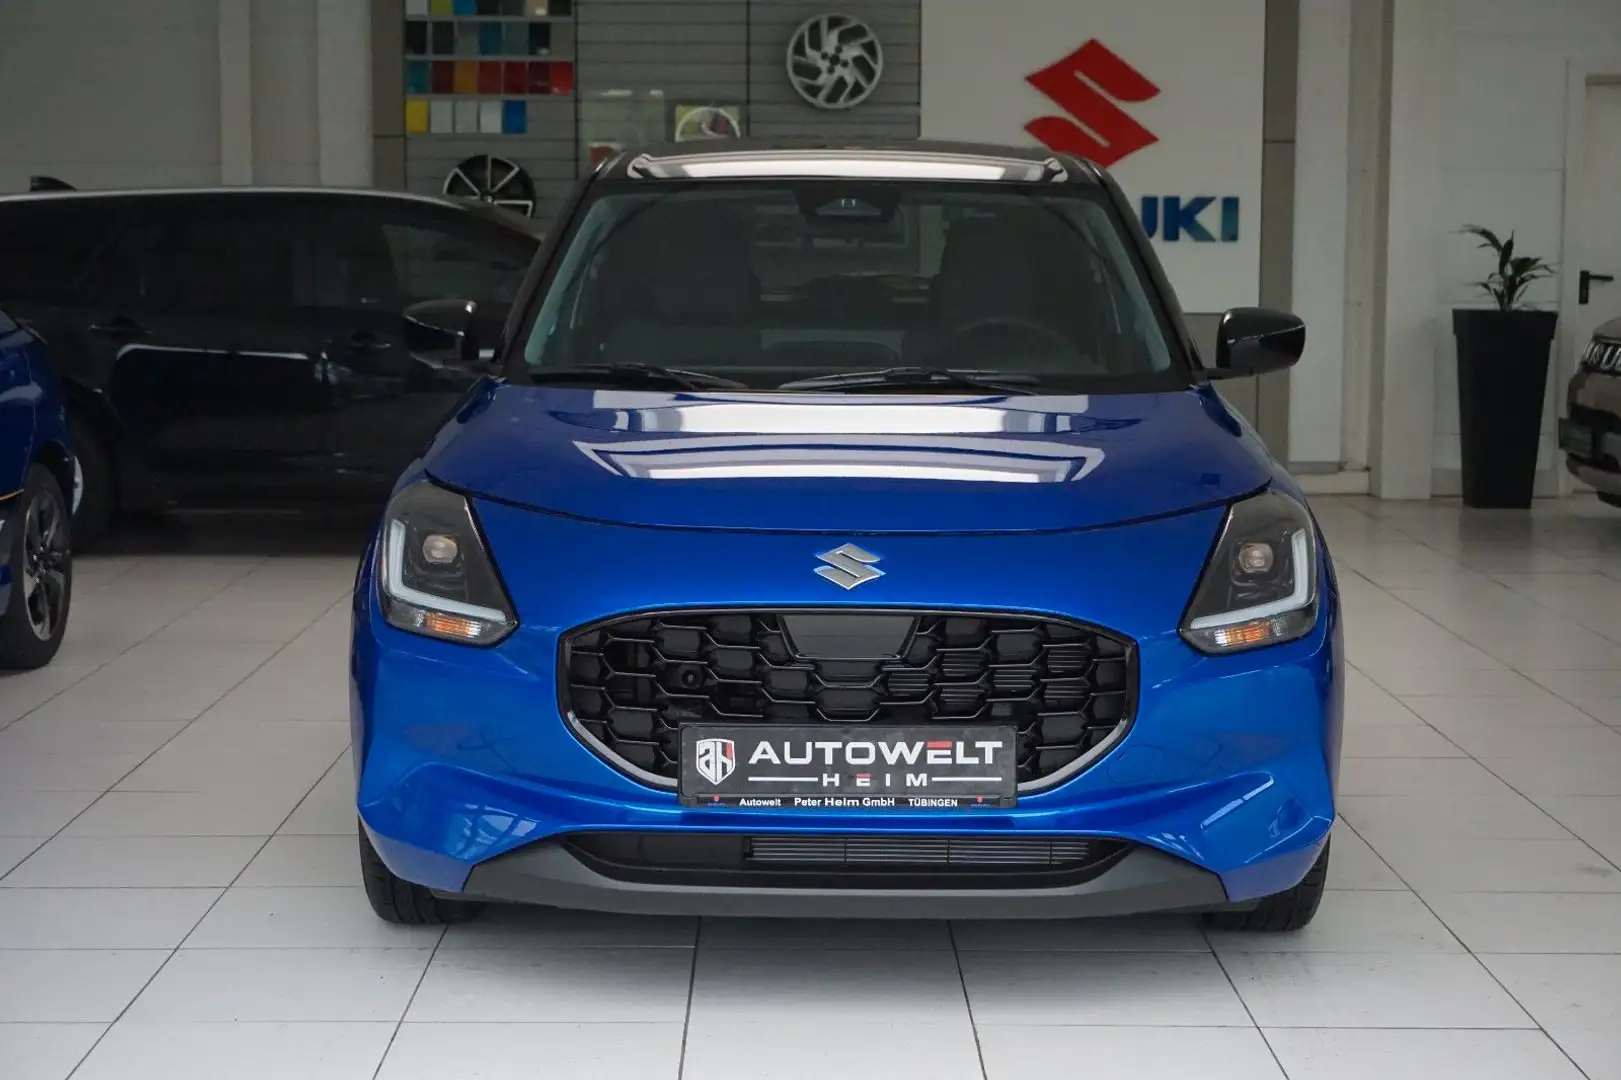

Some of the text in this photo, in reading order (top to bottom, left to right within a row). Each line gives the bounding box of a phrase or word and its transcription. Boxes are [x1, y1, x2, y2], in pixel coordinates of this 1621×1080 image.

[748, 740, 1003, 765] AUTOWELT
[822, 773, 928, 787] HEIM
[739, 797, 958, 807] Autowelt Peter Heim GmbH TÜBINGEN
